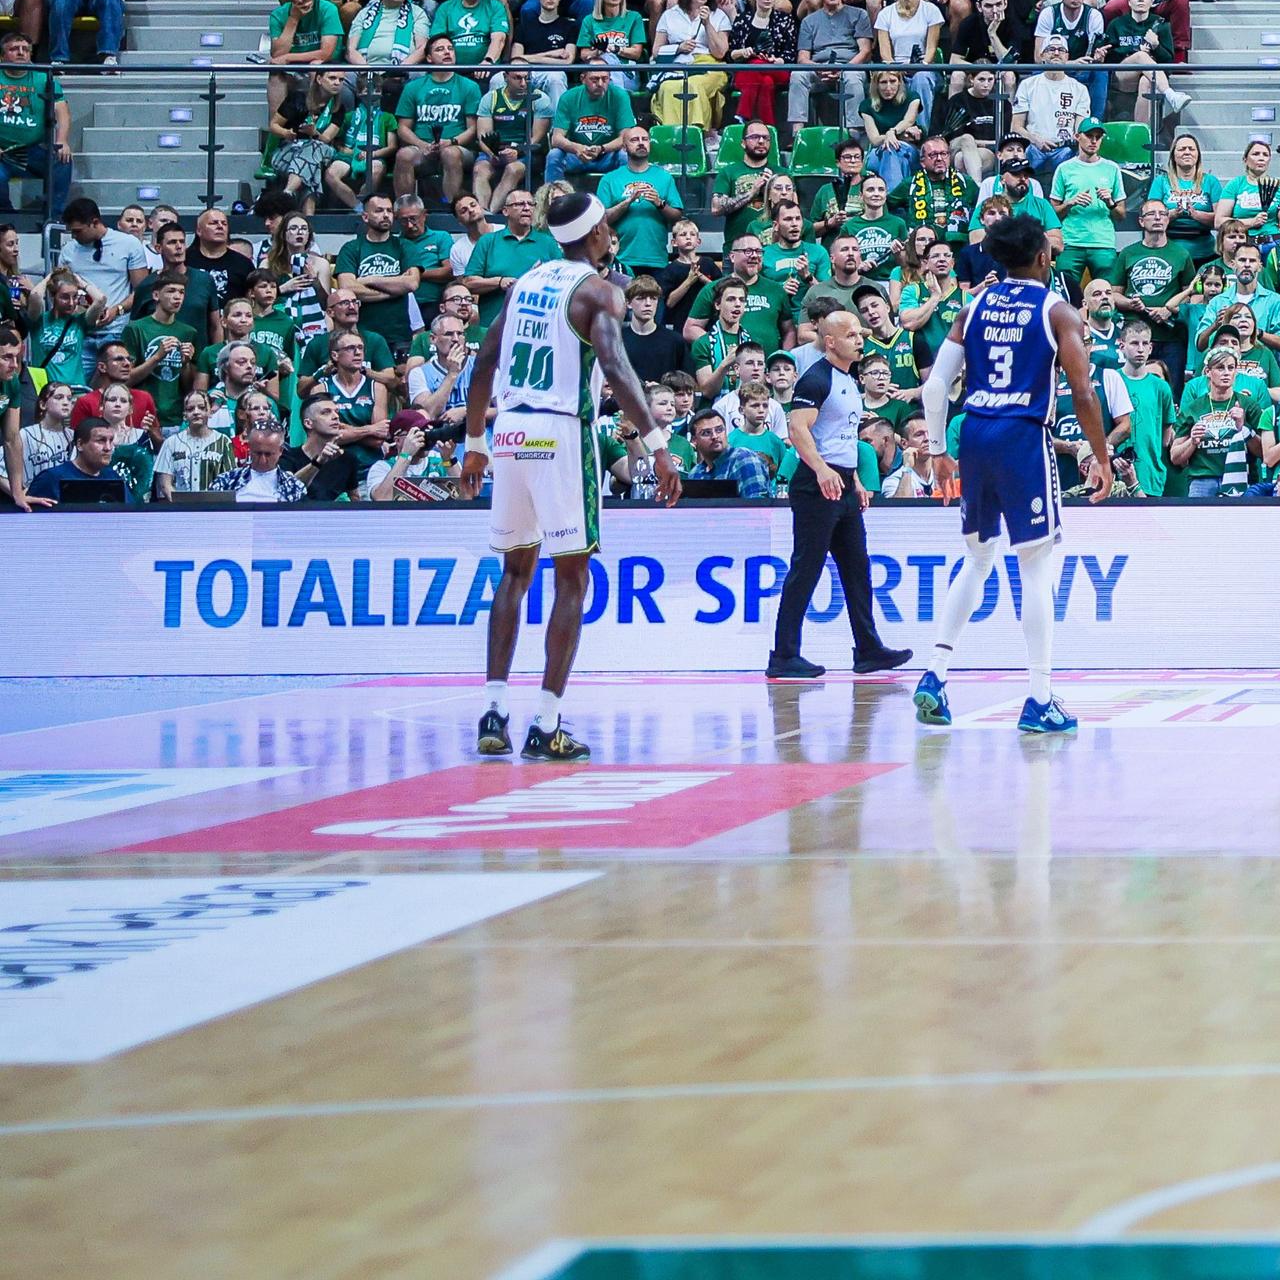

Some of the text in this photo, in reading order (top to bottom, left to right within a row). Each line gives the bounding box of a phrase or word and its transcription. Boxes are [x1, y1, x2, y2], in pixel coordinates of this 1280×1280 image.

[359, 261, 400, 276] Zastal
[1131, 267, 1171, 280] Zastal
[981, 309, 1015, 323] netia
[248, 329, 284, 345] ASTAL
[509, 341, 554, 391] 40
[895, 354, 913, 368] 10
[988, 346, 1013, 388] 3
[494, 431, 526, 447] RICO
